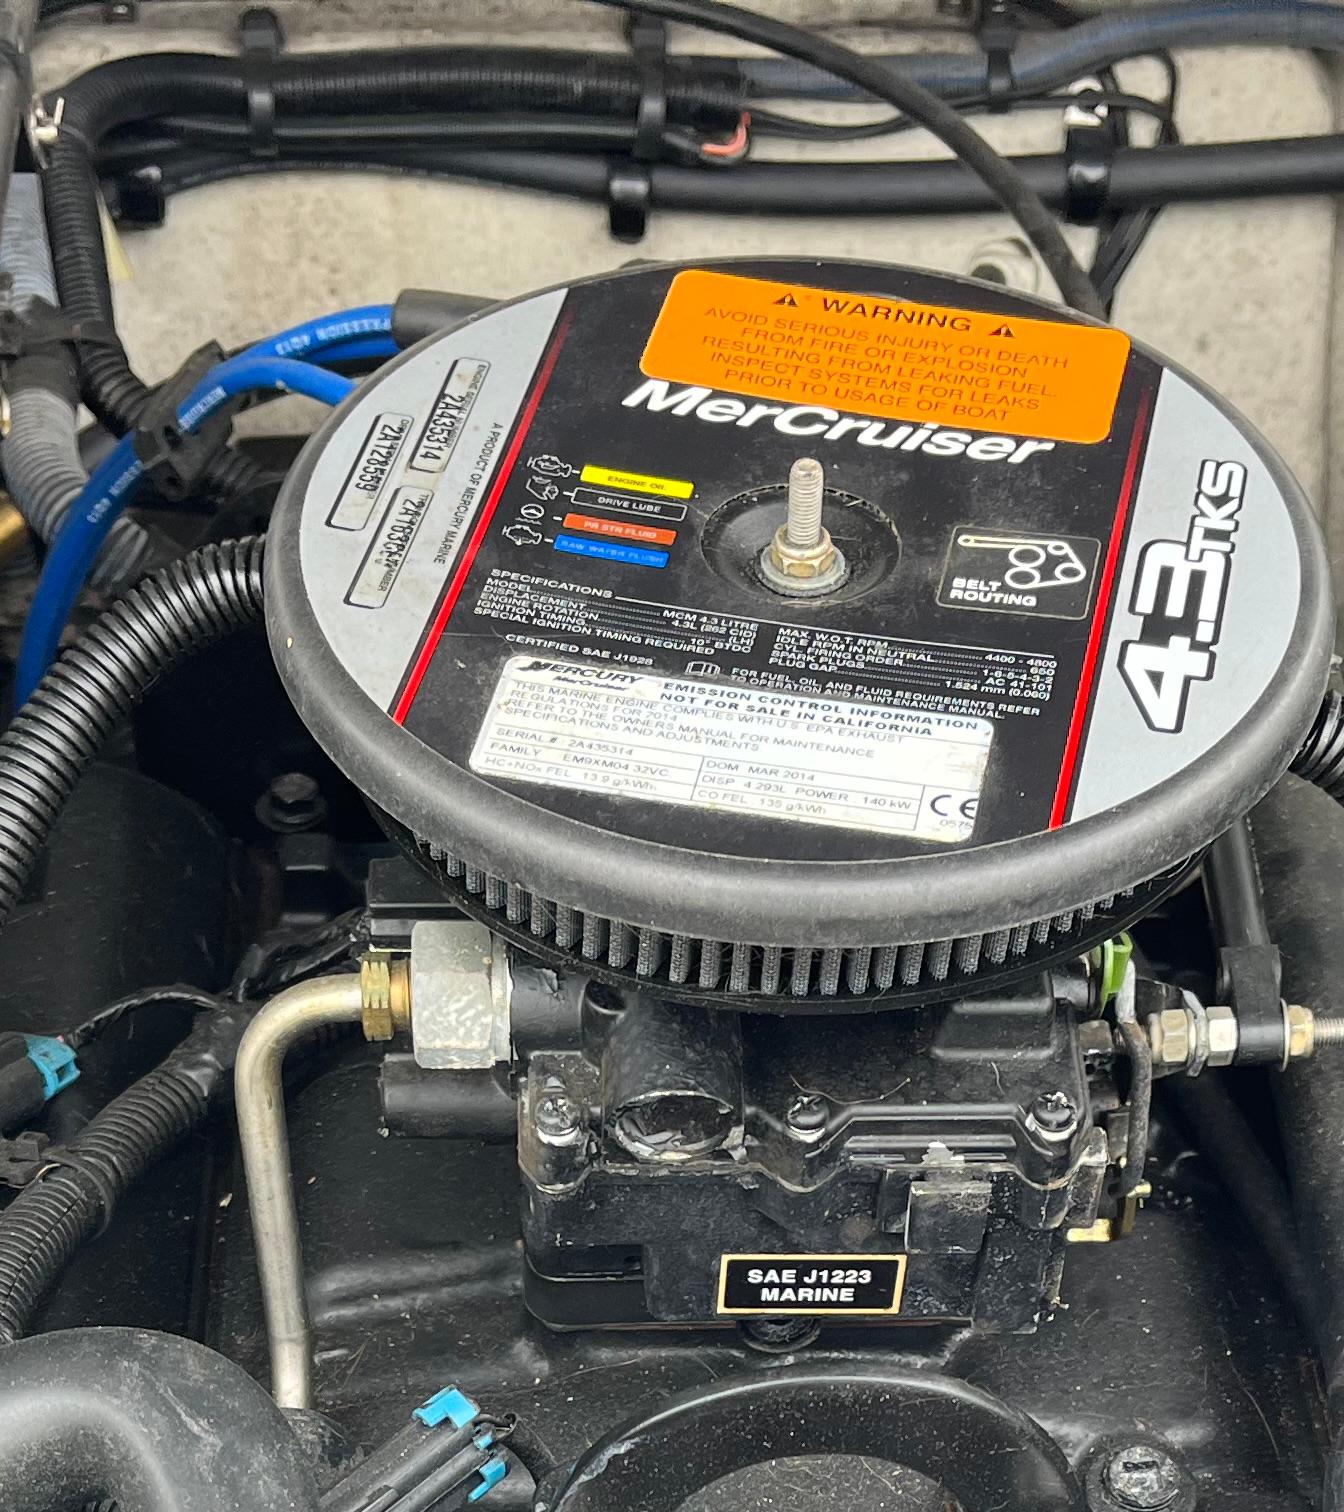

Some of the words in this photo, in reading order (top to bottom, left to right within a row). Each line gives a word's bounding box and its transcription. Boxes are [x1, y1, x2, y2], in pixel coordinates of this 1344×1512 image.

[823, 298, 972, 332] WARNING
[704, 307, 769, 327] AVOID
[775, 317, 869, 340] SERIOUS
[875, 330, 953, 352] INJURY
[958, 340, 991, 358] OR
[996, 348, 1068, 369] DEATH
[742, 327, 804, 347] FROM
[808, 337, 859, 354] FIRE
[863, 344, 896, 360] OR
[903, 352, 1027, 378] EXPLOSION
[702, 336, 824, 365] RESULTING
[827, 354, 890, 374] FROM
[895, 364, 991, 389] LEAKING
[710, 352, 803, 376] INSPECT
[808, 365, 912, 393] SYSTEMS
[918, 382, 965, 399] FOR
[968, 388, 1040, 410] LEAKS
[724, 369, 791, 390] PRIOR
[799, 380, 829, 394] TO
[834, 386, 906, 408] USAGE
[916, 398, 947, 412] OF
[952, 402, 1011, 422] BOAT
[420, 393, 466, 461] 2A435314
[622, 379, 1055, 465] MerCruiser
[355, 424, 402, 492] 2A128559
[477, 432, 499, 469] PRODUCT
[469, 473, 481, 487] OF
[607, 475, 647, 488] ENGINE
[650, 482, 666, 490] OIL
[454, 487, 478, 529] MERCURY
[598, 496, 630, 508] DRIVE
[632, 502, 662, 513] LUBE
[433, 530, 457, 565] MARINE
[625, 528, 657, 538] FLUID
[490, 568, 614, 599] SPECIFICATIONS
[948, 588, 1037, 606] ROUTING
[952, 577, 1002, 592] BELT
[480, 592, 534, 609] ENGINE
[536, 600, 599, 621] ROTATION
[729, 636, 754, 646] (LH)
[482, 584, 587, 610] DISPLACEMENT
[672, 620, 697, 630] 4.3L
[700, 622, 727, 635] (262
[729, 628, 756, 639] CID)
[486, 577, 532, 593] MODEL
[662, 610, 698, 621] MCM
[700, 614, 718, 625] 4.3
[721, 617, 759, 631] LITRE
[474, 607, 529, 624] SPECIAL
[532, 617, 592, 636] IGNITION
[594, 628, 644, 643] TIMING
[646, 635, 715, 656] REQUIRED
[476, 600, 536, 616] IGNITION
[539, 609, 586, 626] TIMING
[714, 640, 752, 654] BTDC
[506, 634, 580, 653] CERTIFIED
[582, 647, 610, 658] SAE
[774, 641, 803, 654] CYL.
[806, 648, 851, 662] FIRING
[853, 654, 903, 666] ORDER
[775, 634, 808, 646] IDLE
[812, 639, 845, 651] RPM
[848, 646, 864, 655] IN
[867, 647, 935, 664] NEUTRAL
[778, 627, 812, 640] MAX.
[815, 632, 854, 646] W.O.T.
[858, 638, 888, 649] RPM
[984, 652, 1015, 664] 4400
[1025, 658, 1057, 668] 4800
[518, 660, 644, 685] MERCURY
[768, 658, 804, 669] PLUG
[808, 662, 837, 674] GAP
[980, 686, 1007, 694] mm
[770, 649, 814, 663] SPARK
[817, 658, 865, 670] PLUGS
[985, 677, 1005, 688] AC
[1009, 679, 1052, 692] 41-101
[660, 693, 698, 706] NOT
[704, 700, 739, 711] FOR
[745, 704, 789, 718] SALE
[796, 710, 816, 721] IN
[822, 714, 933, 736] CALIFORNIA
[663, 681, 752, 702] EMISSION
[758, 695, 842, 714] CONTROL
[849, 706, 978, 730] INFORMATION
[496, 728, 543, 743] SERIAL
[748, 1269, 796, 1283] SAE
[804, 1270, 872, 1283] J1223
[761, 1288, 855, 1302] MARINE
